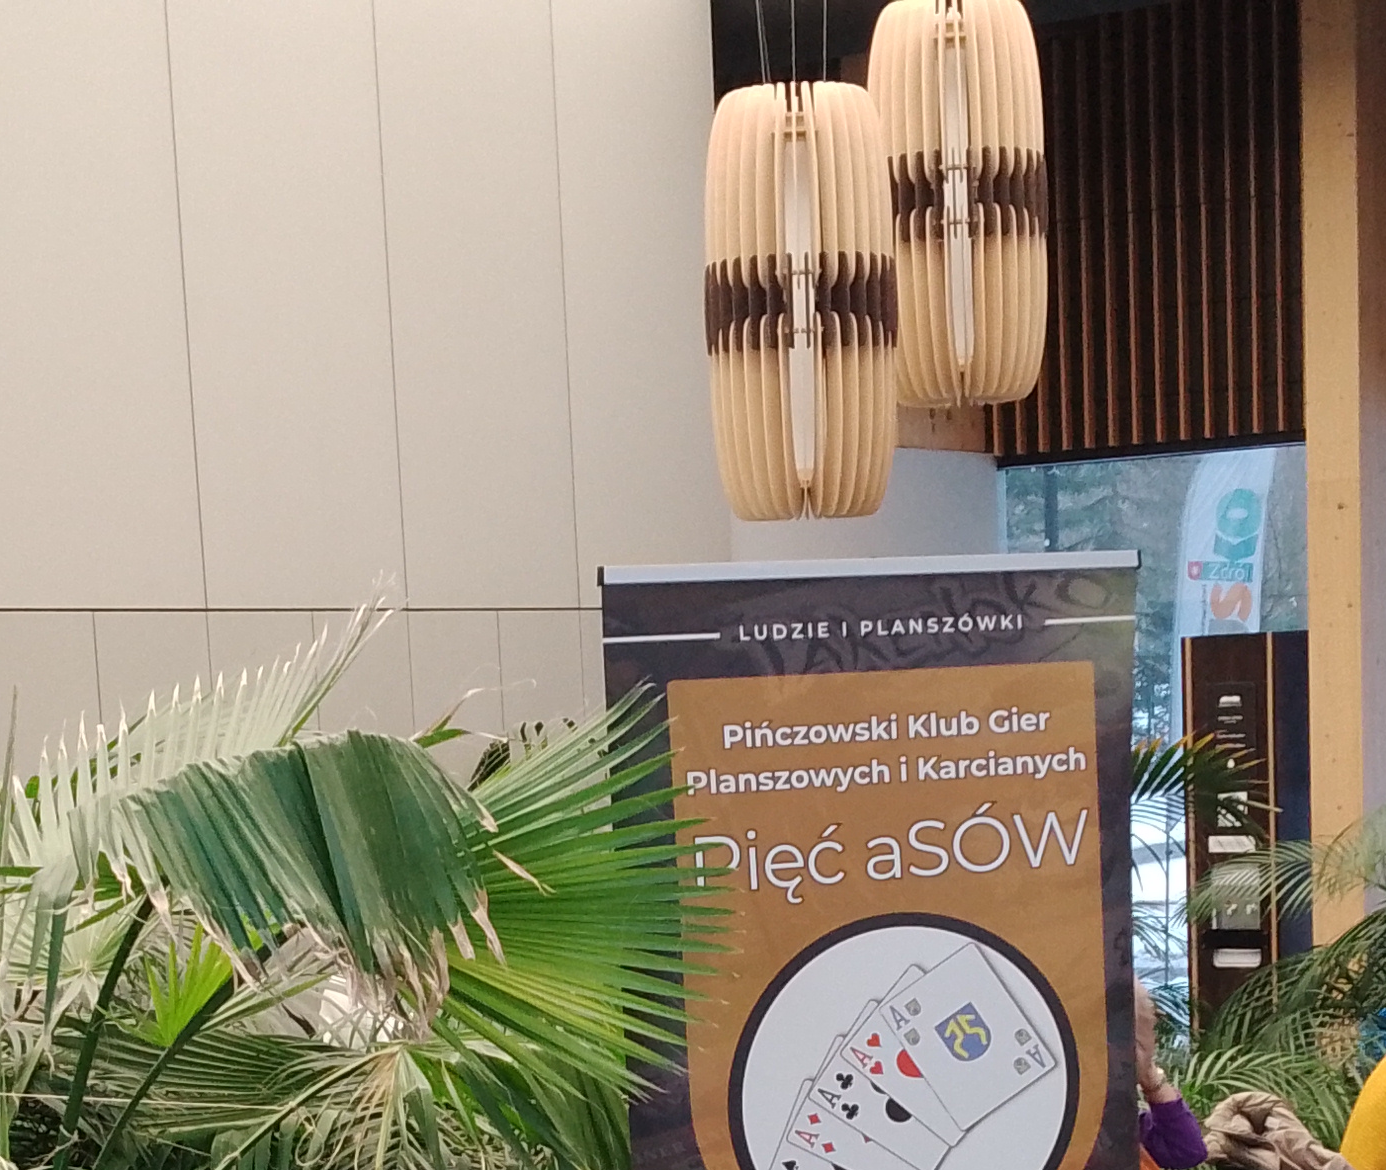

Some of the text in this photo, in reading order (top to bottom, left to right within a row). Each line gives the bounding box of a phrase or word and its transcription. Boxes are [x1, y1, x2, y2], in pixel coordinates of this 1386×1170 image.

[739, 613, 1024, 641] LUDZIE I PLANSZÓWKI
[722, 707, 1051, 750] Pińczowski Klub Gier
[685, 747, 1087, 796] Planszowych i Karcianych
[692, 801, 1089, 905] Pięć aSÓW
